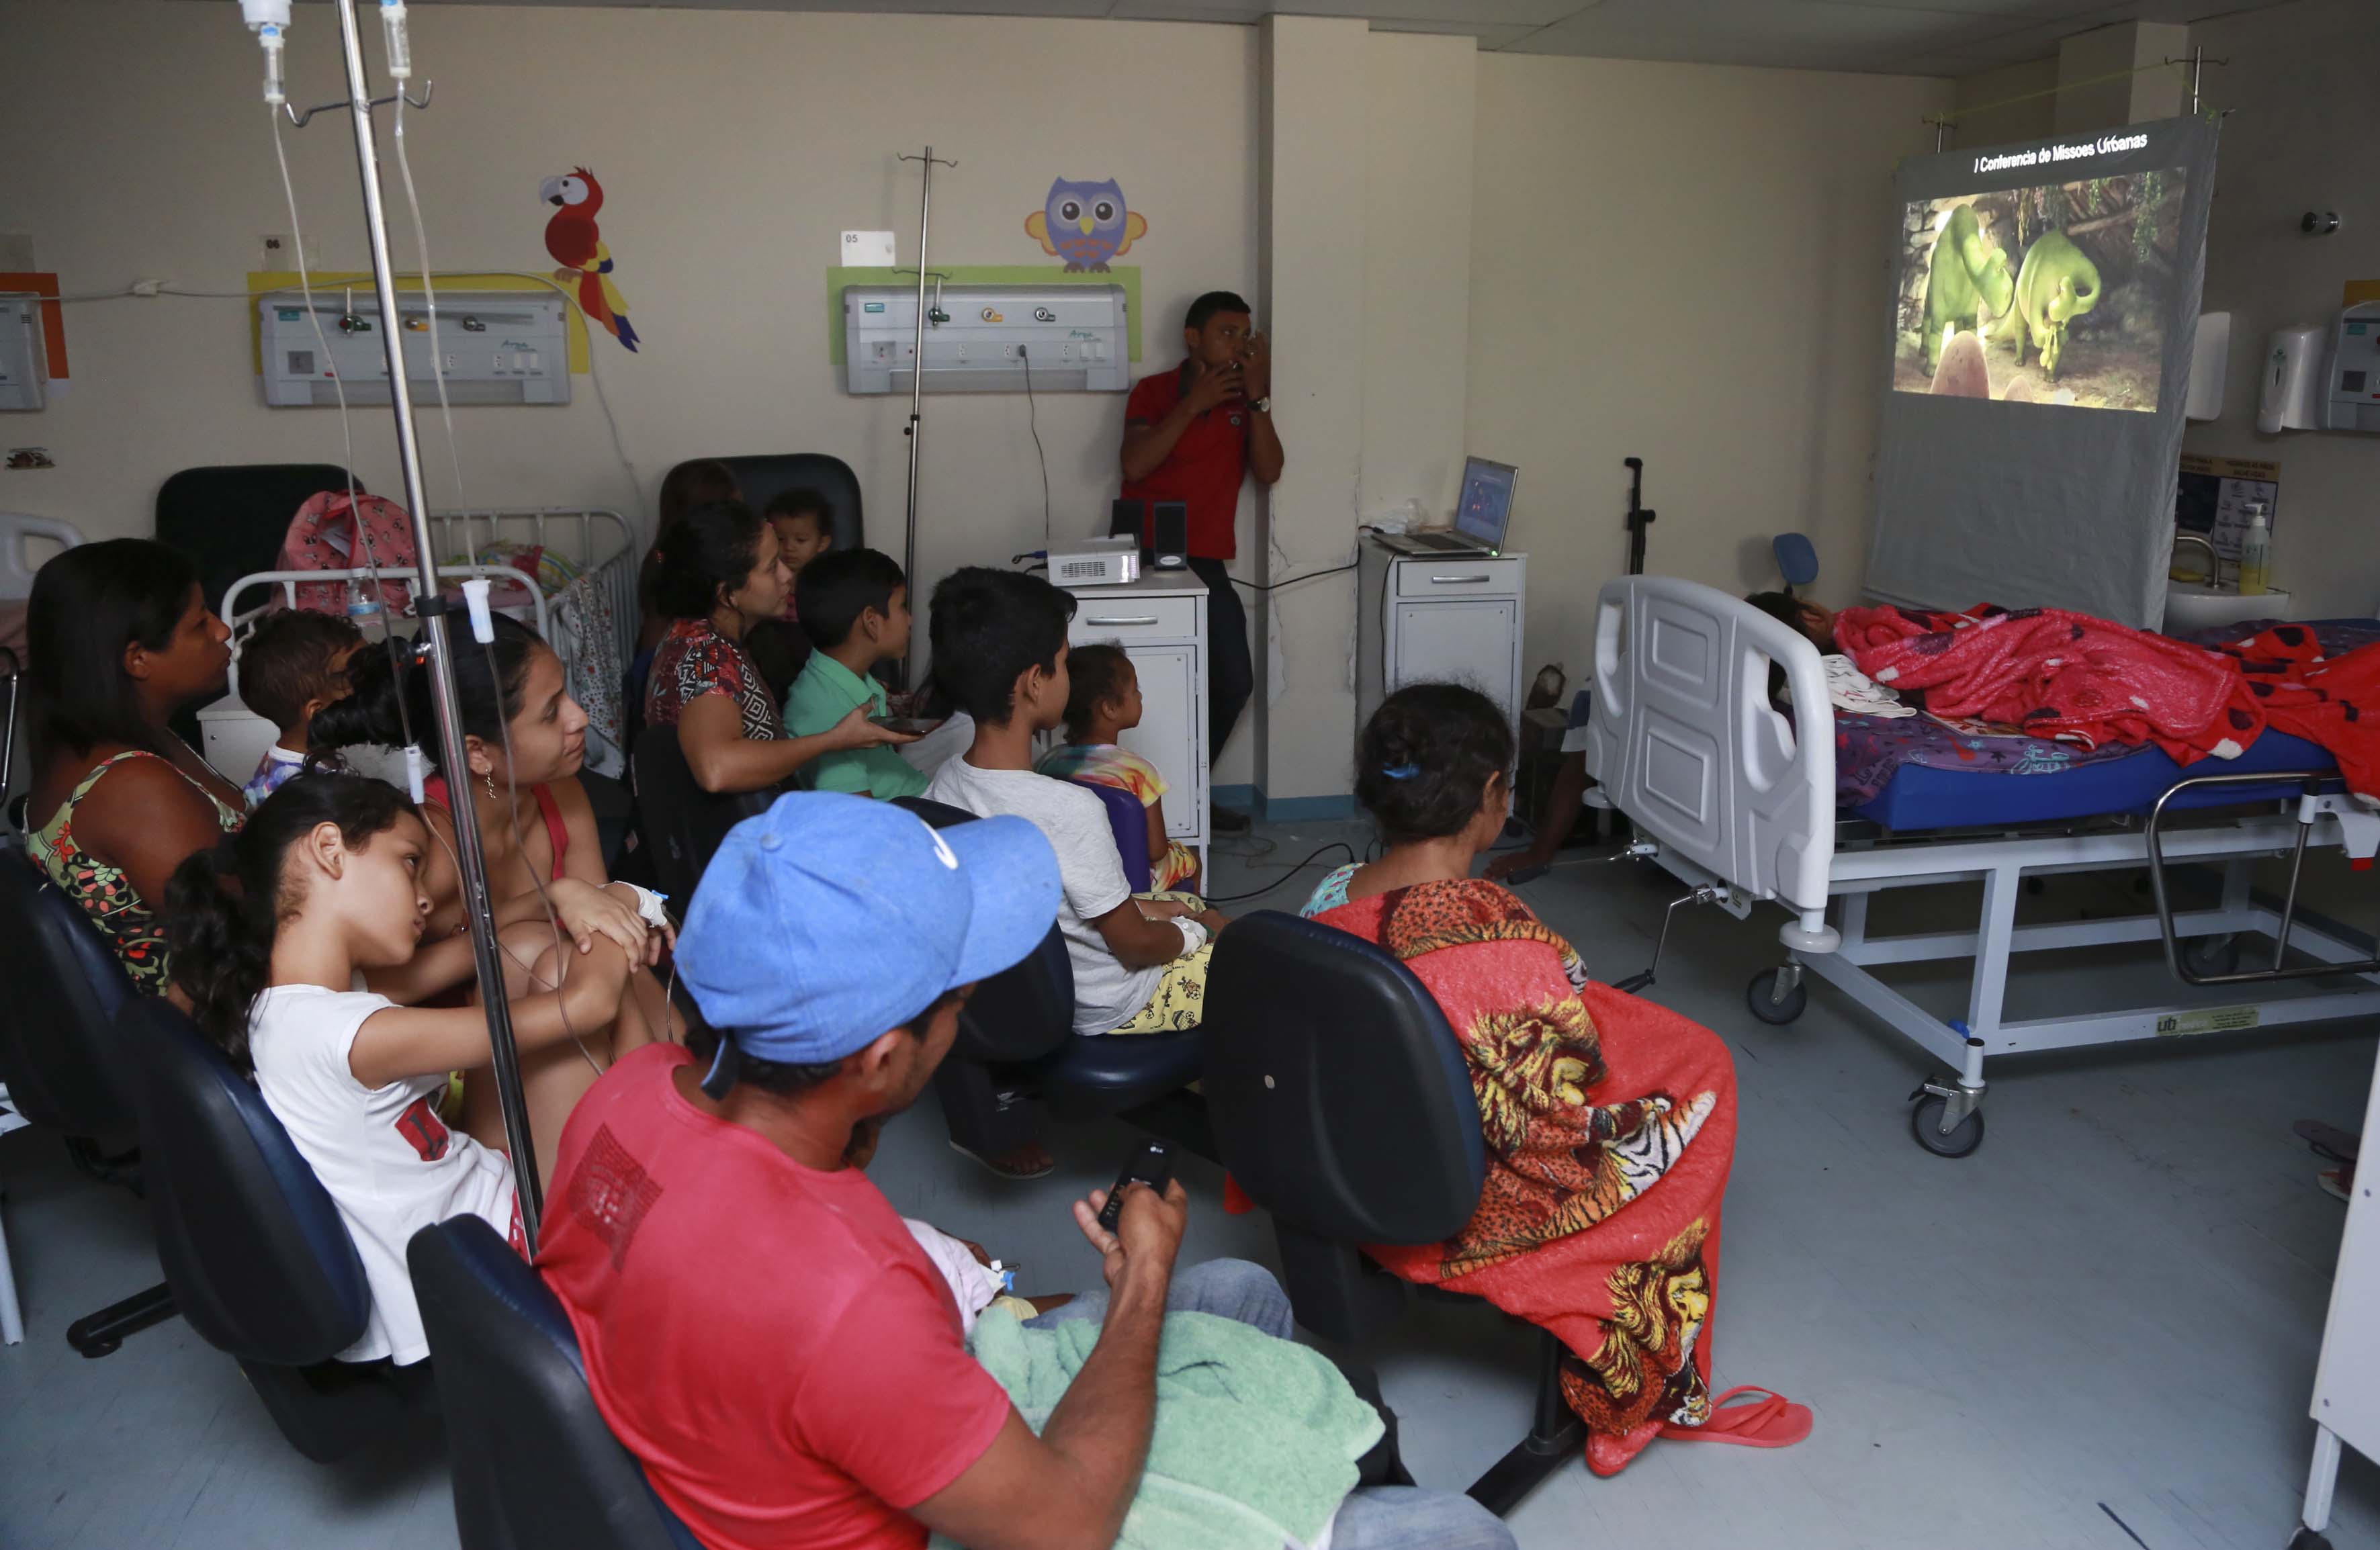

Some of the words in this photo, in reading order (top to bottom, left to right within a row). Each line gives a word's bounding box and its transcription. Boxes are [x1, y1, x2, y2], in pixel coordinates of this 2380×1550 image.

[1980, 150, 2037, 173] Conferencia
[2038, 147, 2052, 164] de
[2052, 143, 2095, 162] Missoes
[2097, 134, 2148, 154] Urbanas
[846, 234, 858, 243] 05
